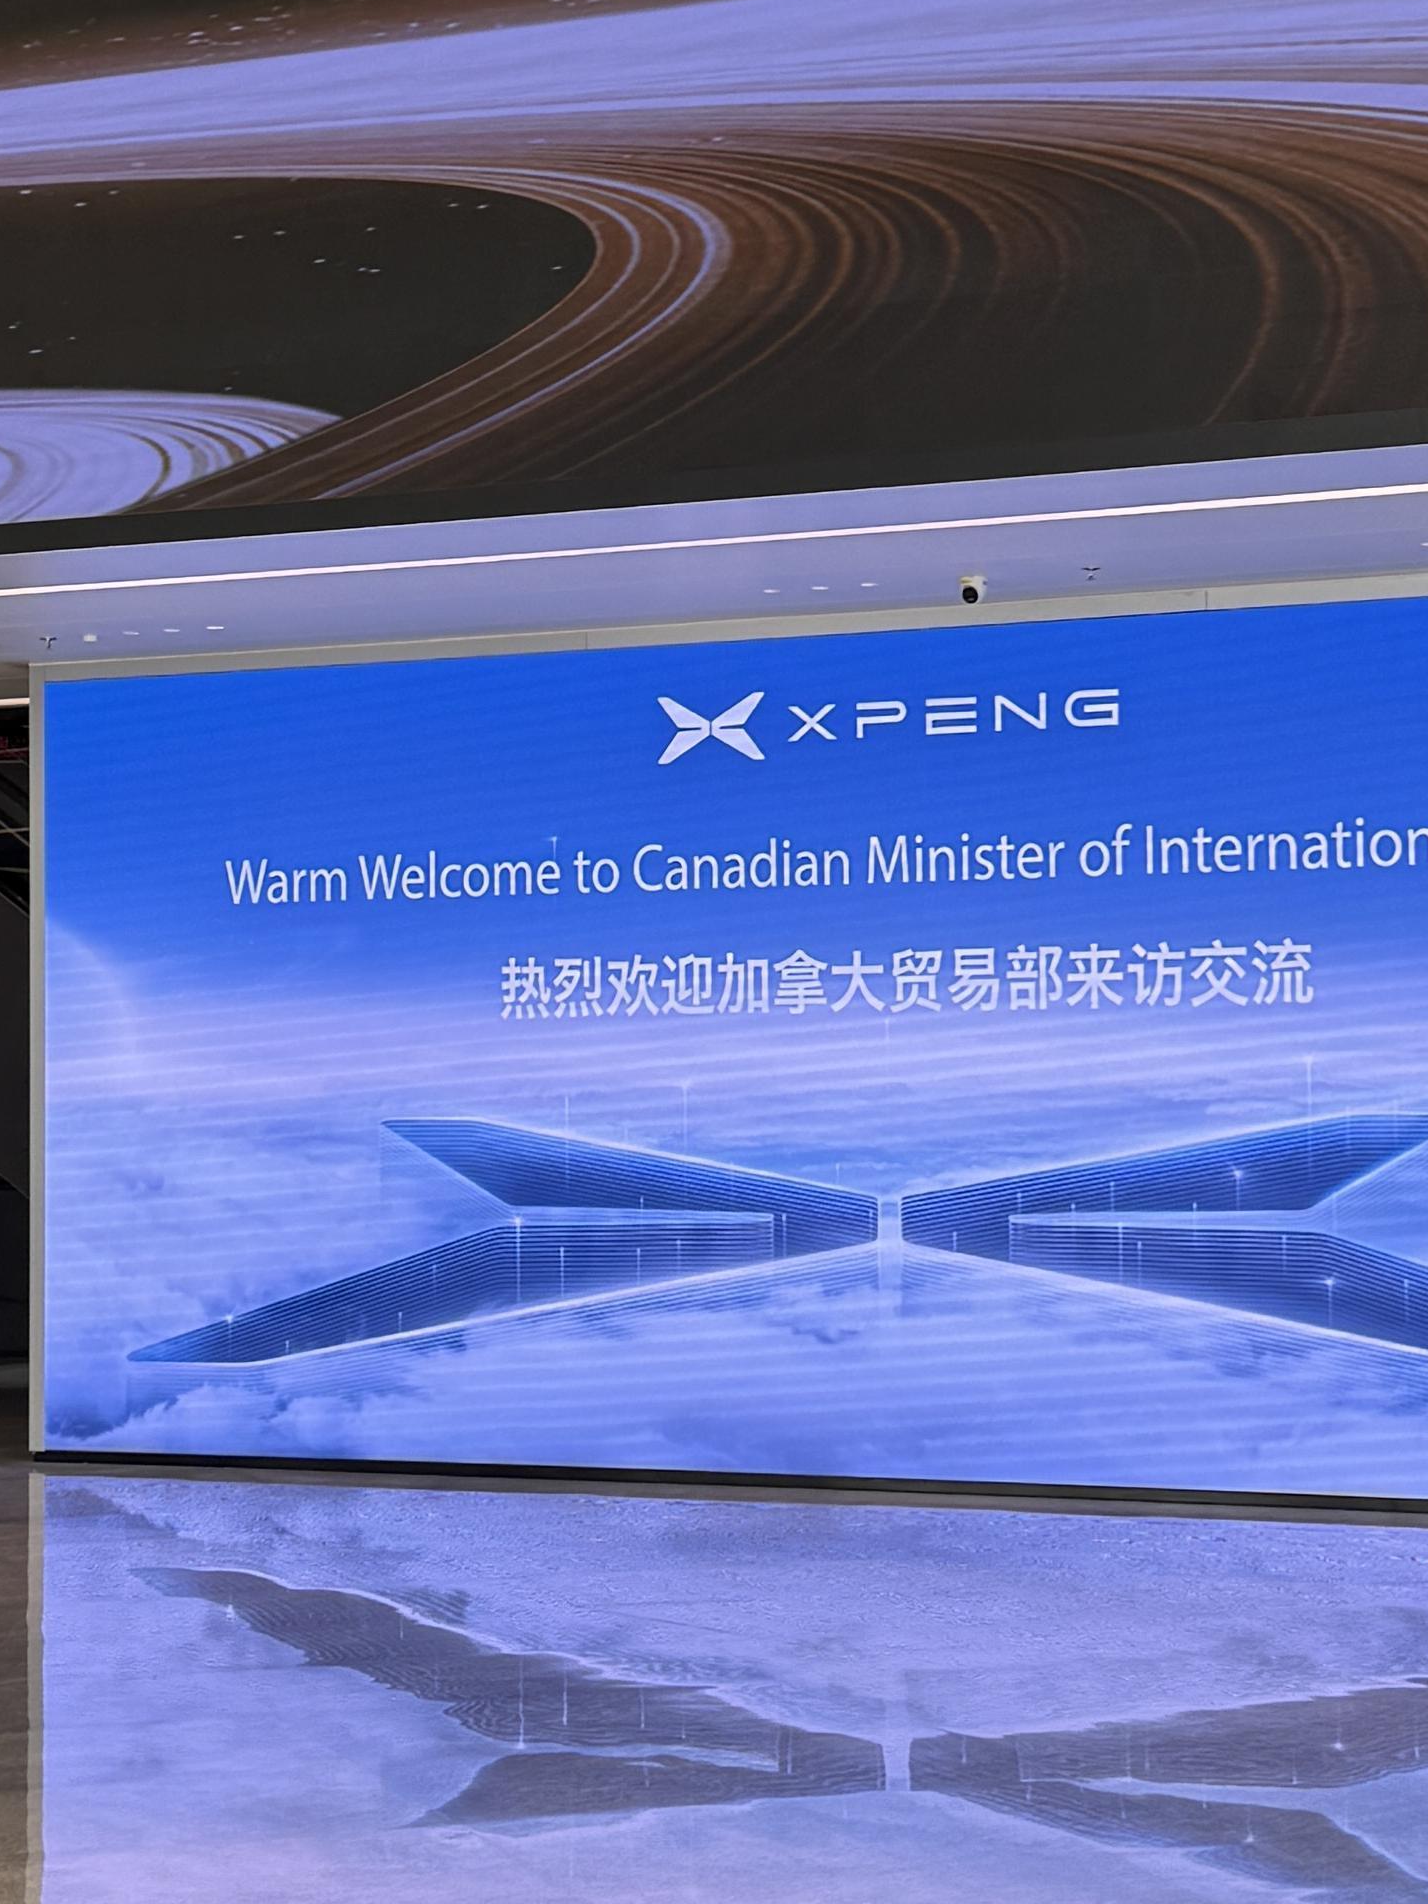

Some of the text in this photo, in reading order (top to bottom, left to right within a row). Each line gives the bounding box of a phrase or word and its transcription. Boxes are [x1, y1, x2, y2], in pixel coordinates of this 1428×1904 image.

[787, 688, 1121, 743] XPENG
[224, 858, 348, 905] Warm
[358, 850, 562, 901] Welcome
[573, 850, 620, 895] to
[632, 838, 851, 892] Canadian
[868, 832, 1066, 884] Minister
[1078, 824, 1133, 878] of
[501, 938, 1315, 1020] 热烈欢迎加拿大贸易部来访交流
